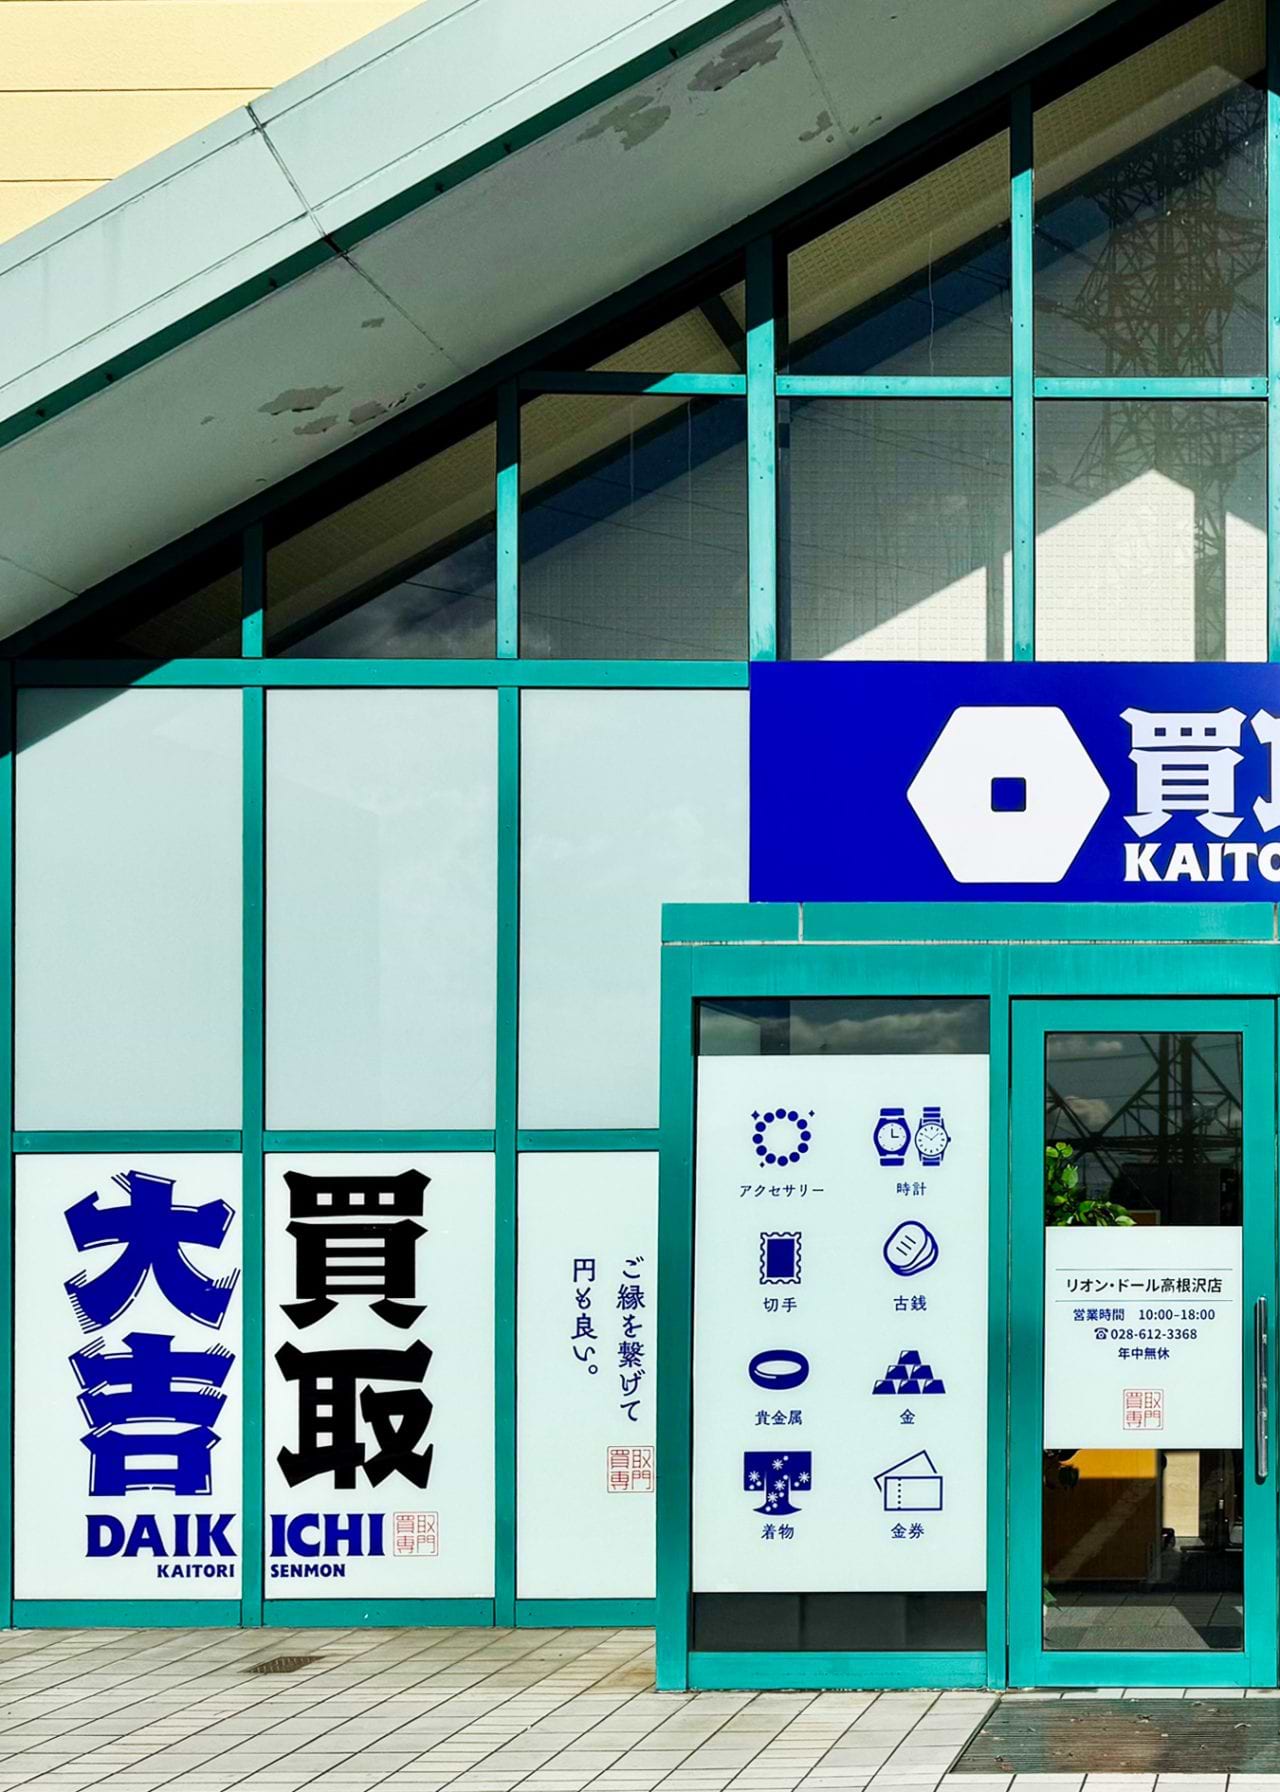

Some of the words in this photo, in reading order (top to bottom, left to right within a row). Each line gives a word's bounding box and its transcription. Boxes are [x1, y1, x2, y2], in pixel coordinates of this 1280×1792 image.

[740, 1184, 824, 1197] アクセサリー
[897, 1182, 926, 1196] 時計
[1067, 1278, 1222, 1293] リオン・ドール高根沢店
[763, 1297, 797, 1312] 切手
[893, 1295, 927, 1311] 古銭
[571, 1259, 598, 1374] 円も良い。
[1073, 1308, 1124, 1321] 営業時間
[64, 1170, 240, 1496] 大吉
[275, 1169, 433, 1489] 買取
[1111, 1329, 1197, 1340] 028-612-3368
[616, 1256, 645, 1421] ご縁を繋げて
[1118, 1347, 1169, 1360] 年中無休
[755, 1410, 802, 1425] 貴金属
[900, 1409, 915, 1424] 金
[612, 1450, 652, 1470] 買取
[761, 1524, 794, 1540] 着物
[891, 1523, 924, 1539] 金券
[158, 1564, 234, 1577] KAITORI
[271, 1564, 345, 1577] SENMON
